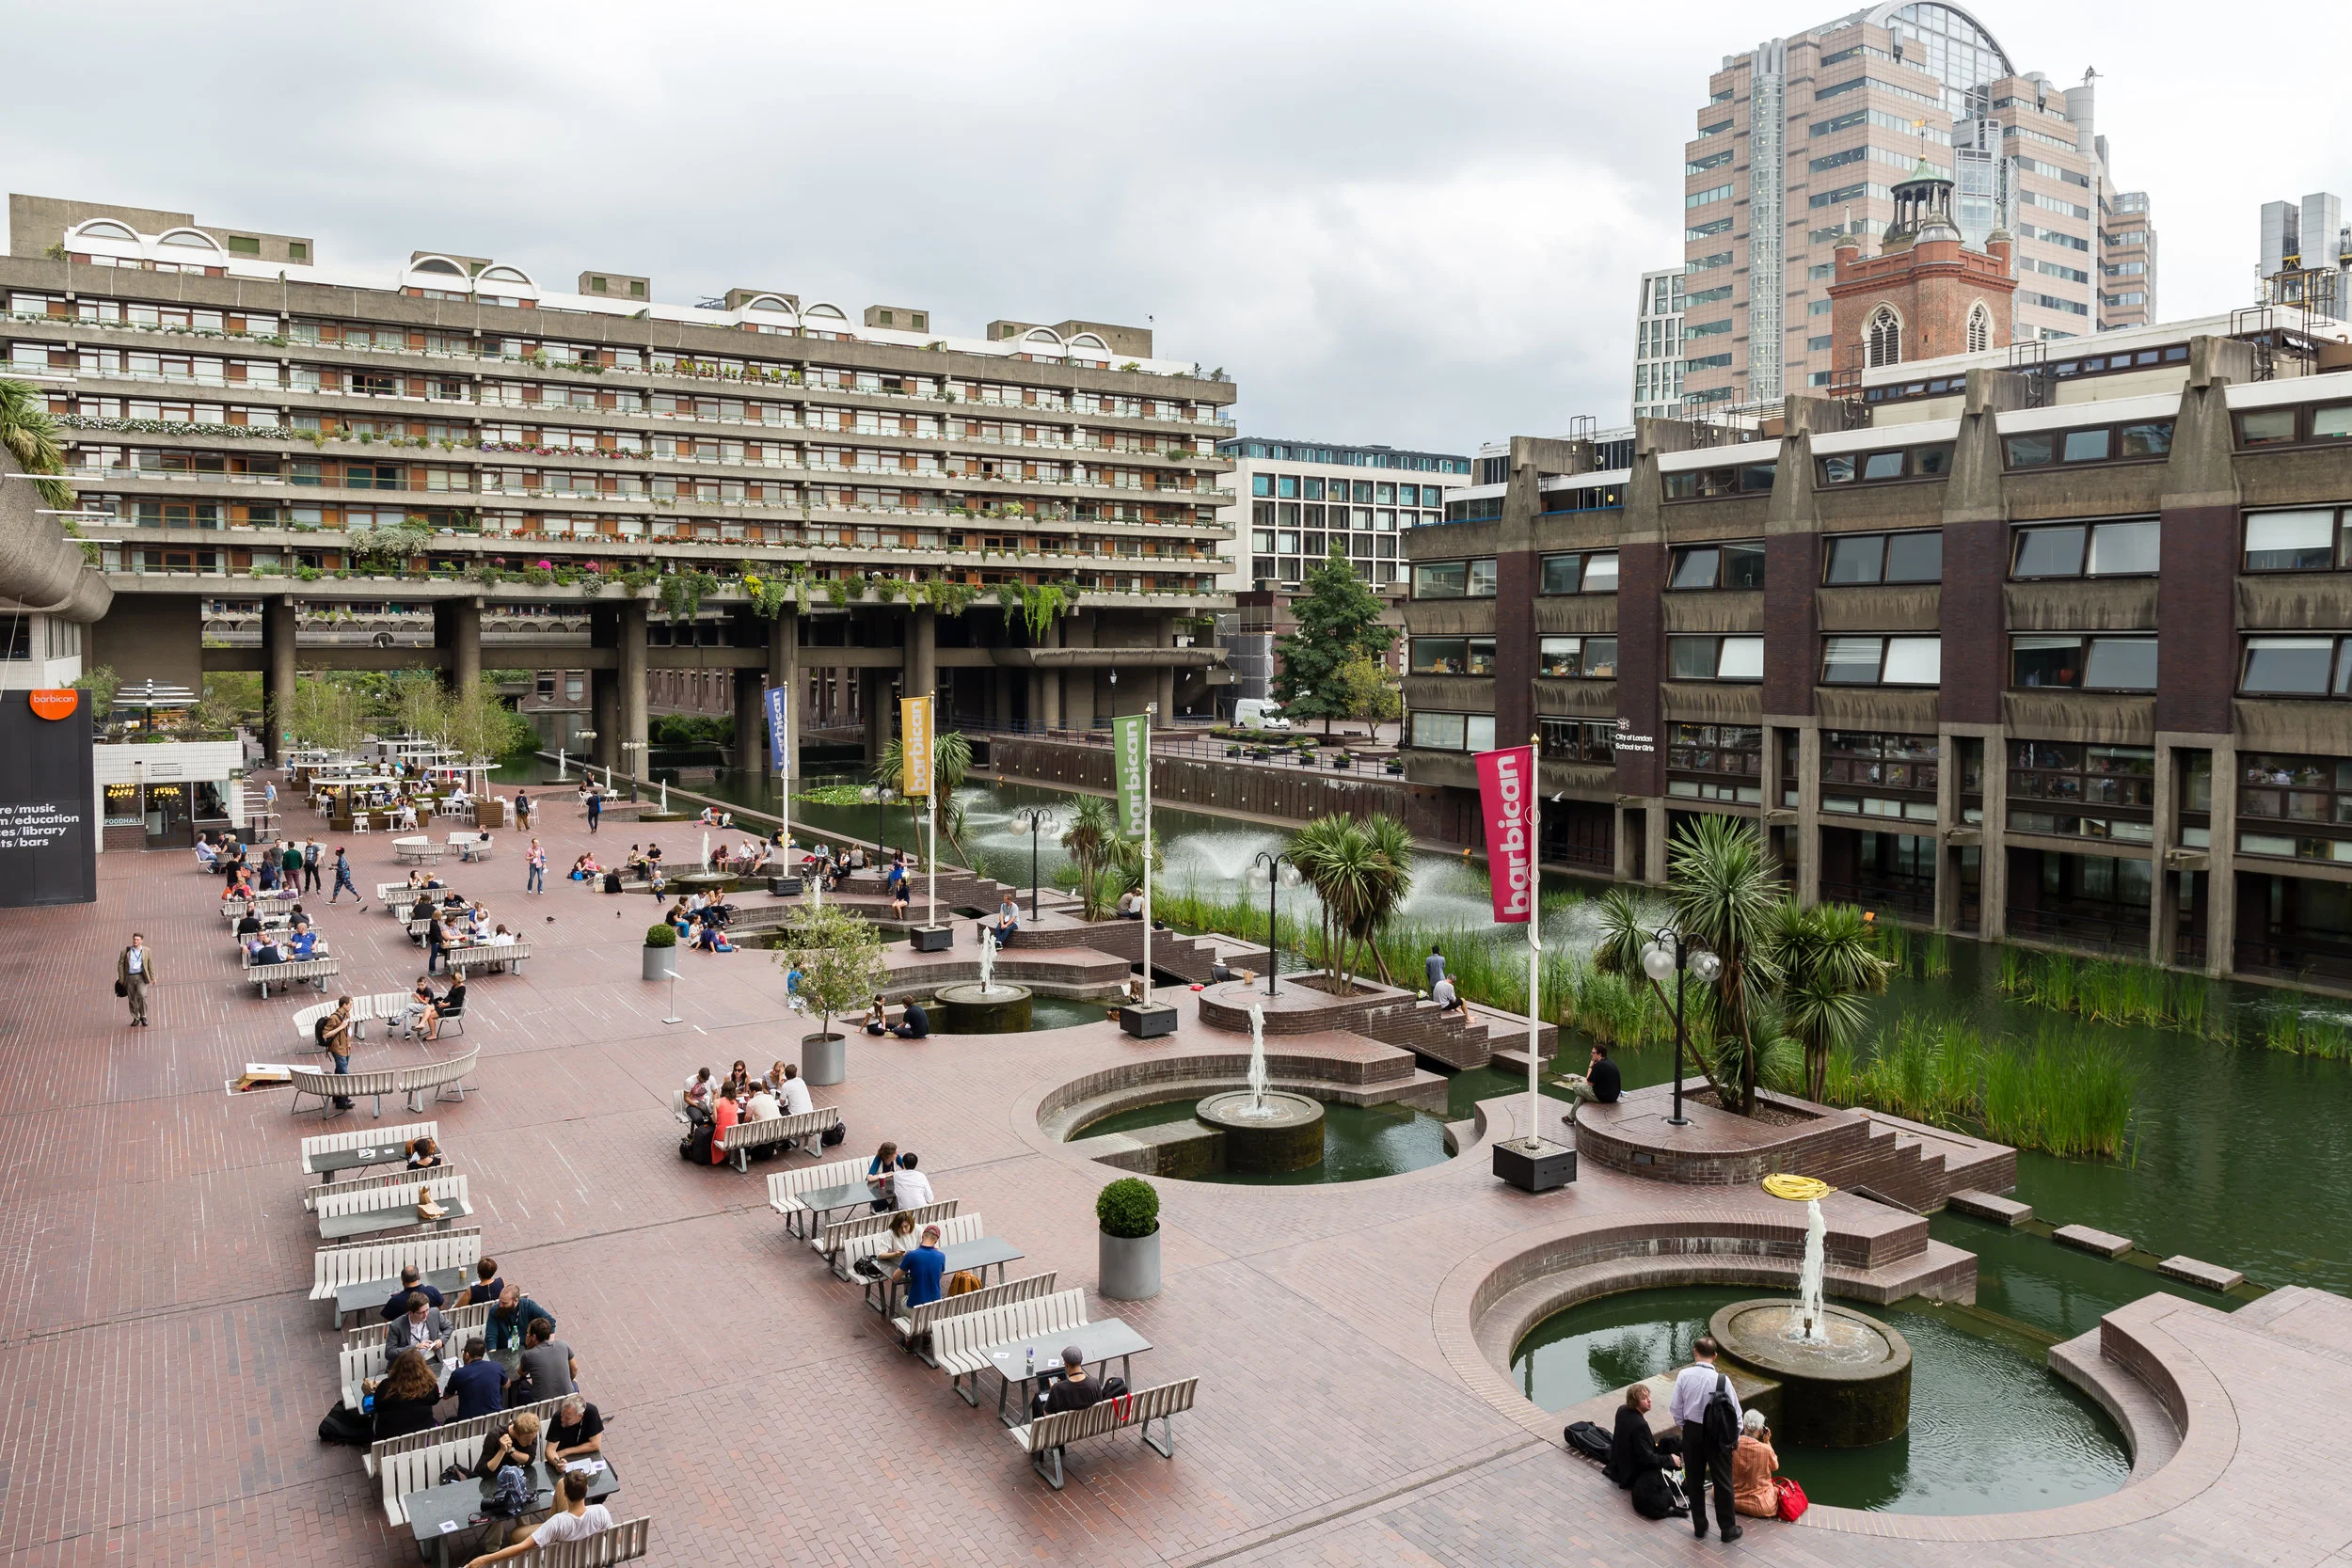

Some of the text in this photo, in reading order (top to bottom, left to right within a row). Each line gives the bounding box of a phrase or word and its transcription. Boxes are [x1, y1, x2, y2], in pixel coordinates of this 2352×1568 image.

[33, 694, 74, 703] barbican
[908, 701, 927, 792] barbican
[1124, 721, 1145, 836] barbican
[0, 826, 67, 837] es/library
[1497, 754, 1530, 914] barbican
